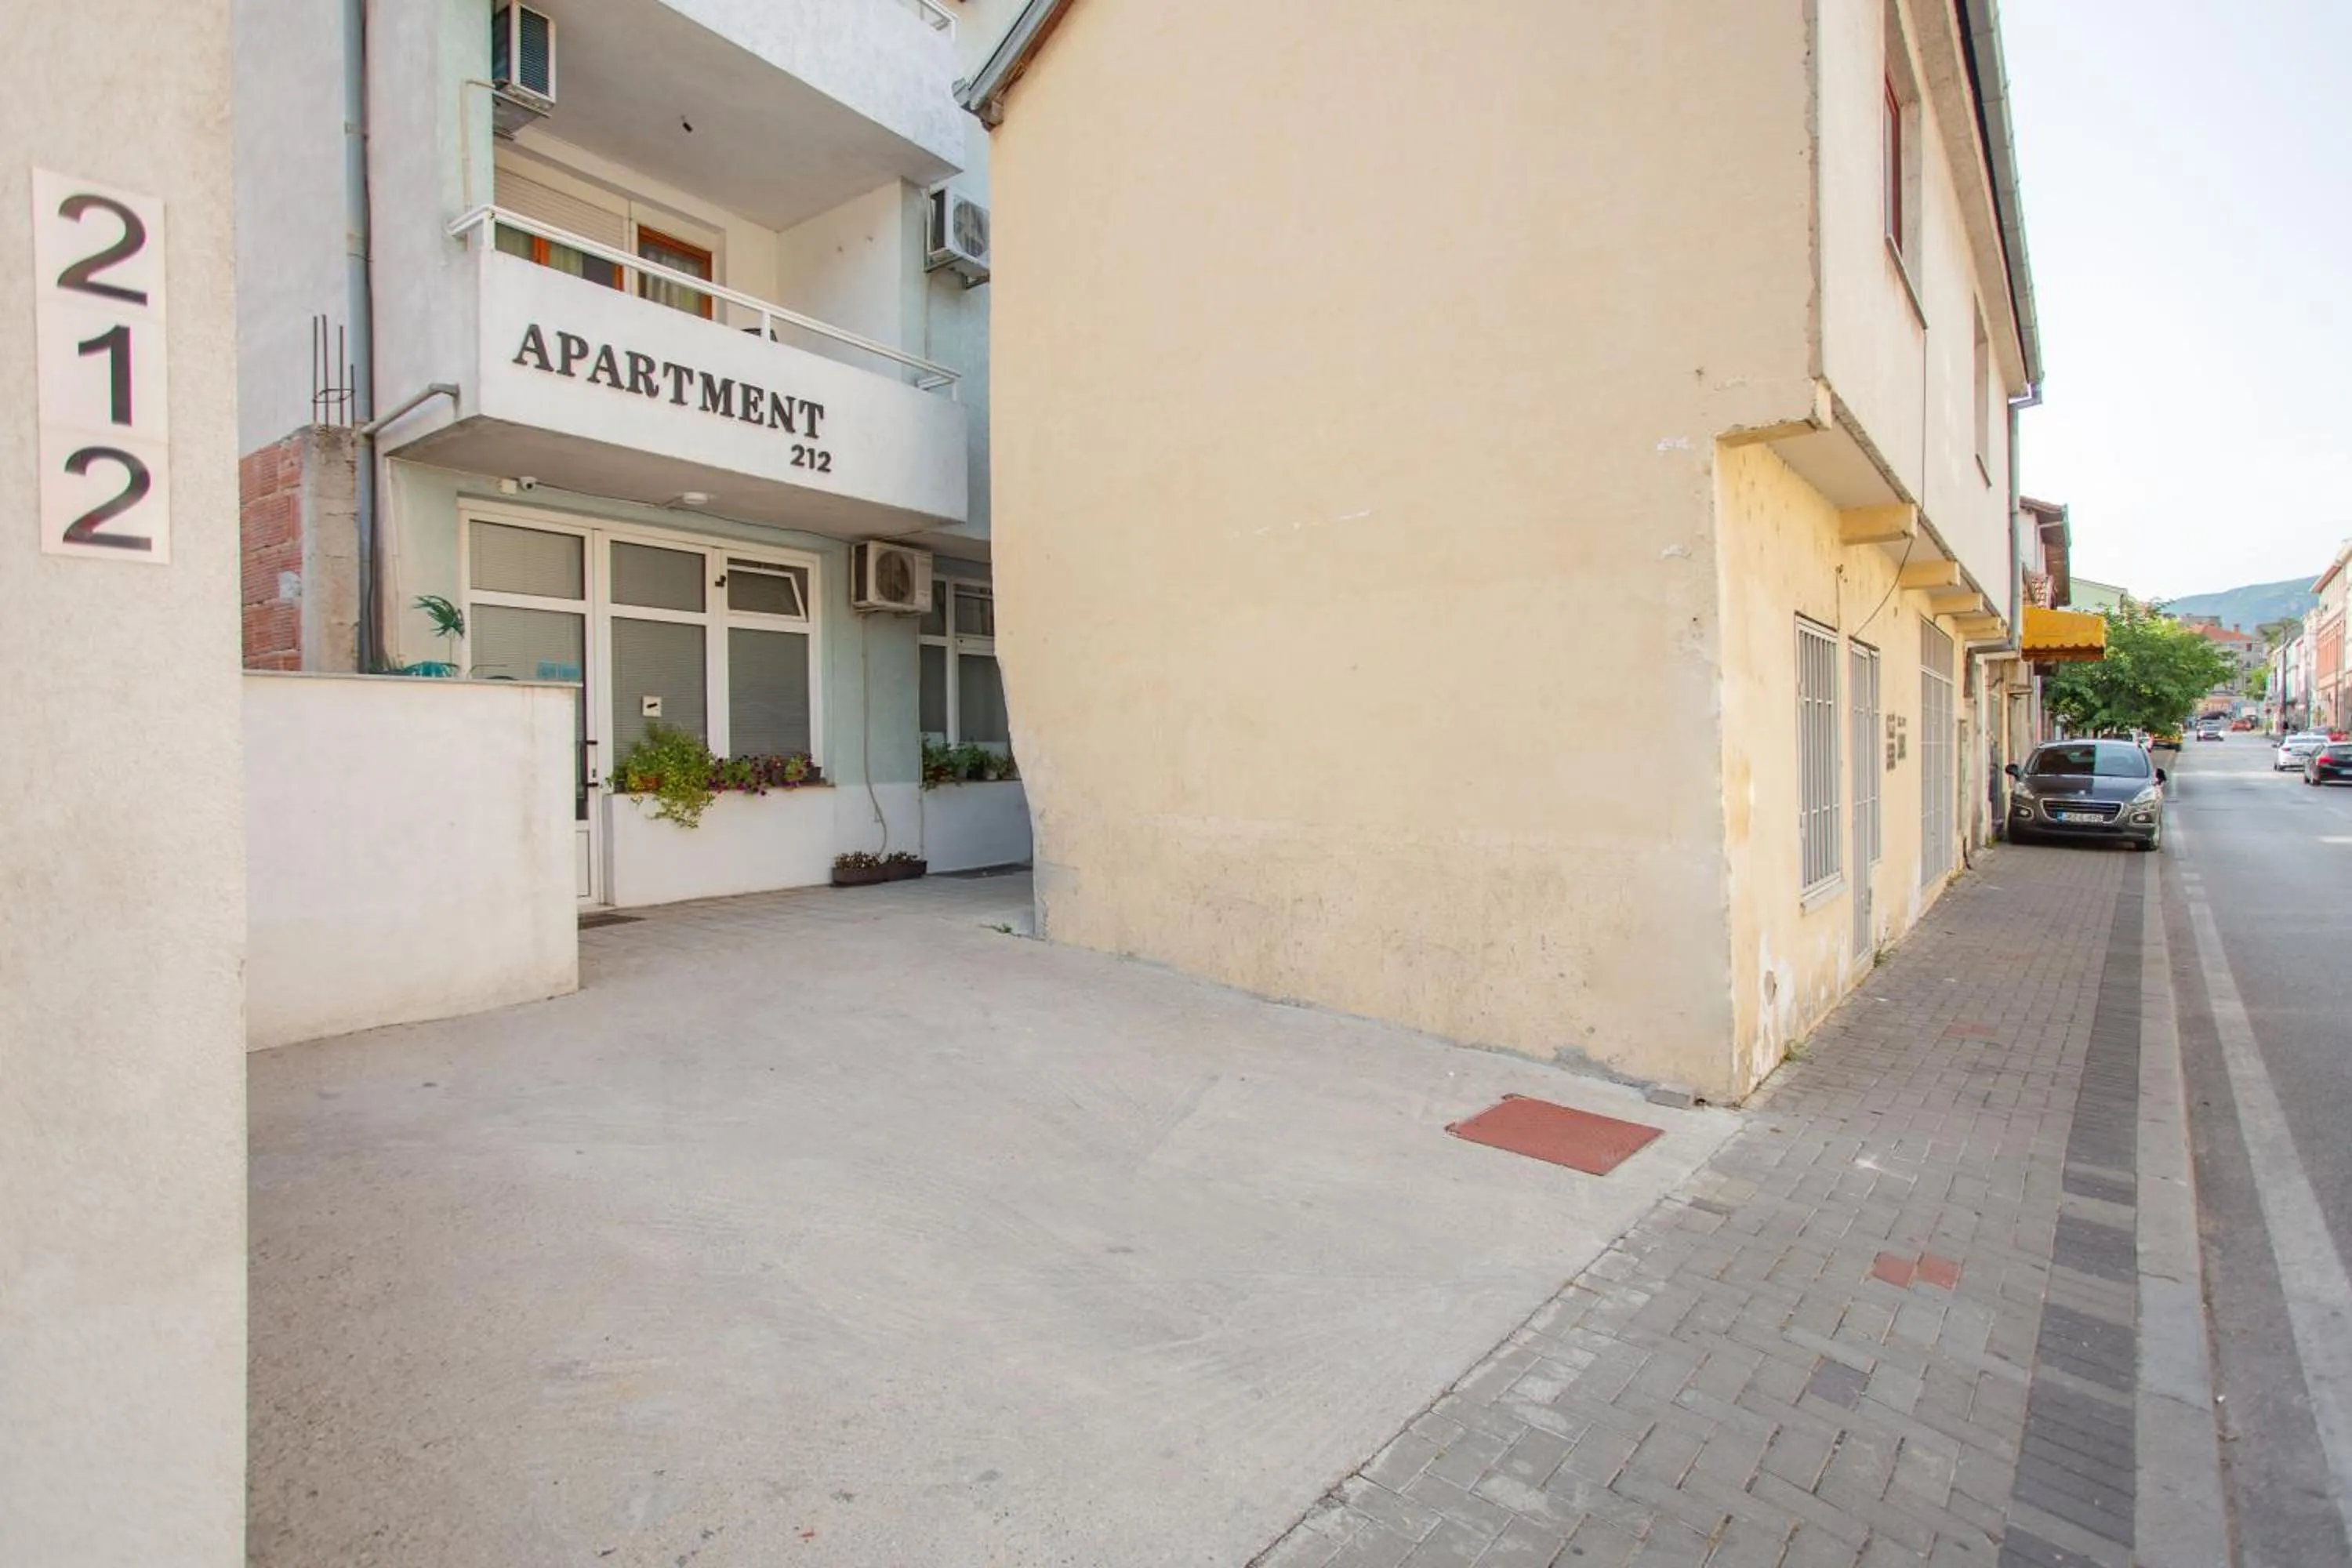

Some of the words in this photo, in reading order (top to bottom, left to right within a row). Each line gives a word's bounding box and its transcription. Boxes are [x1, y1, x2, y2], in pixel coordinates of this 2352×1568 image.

[56, 194, 152, 552] 212
[512, 323, 825, 440] APARTMENT
[789, 443, 833, 474] 212
